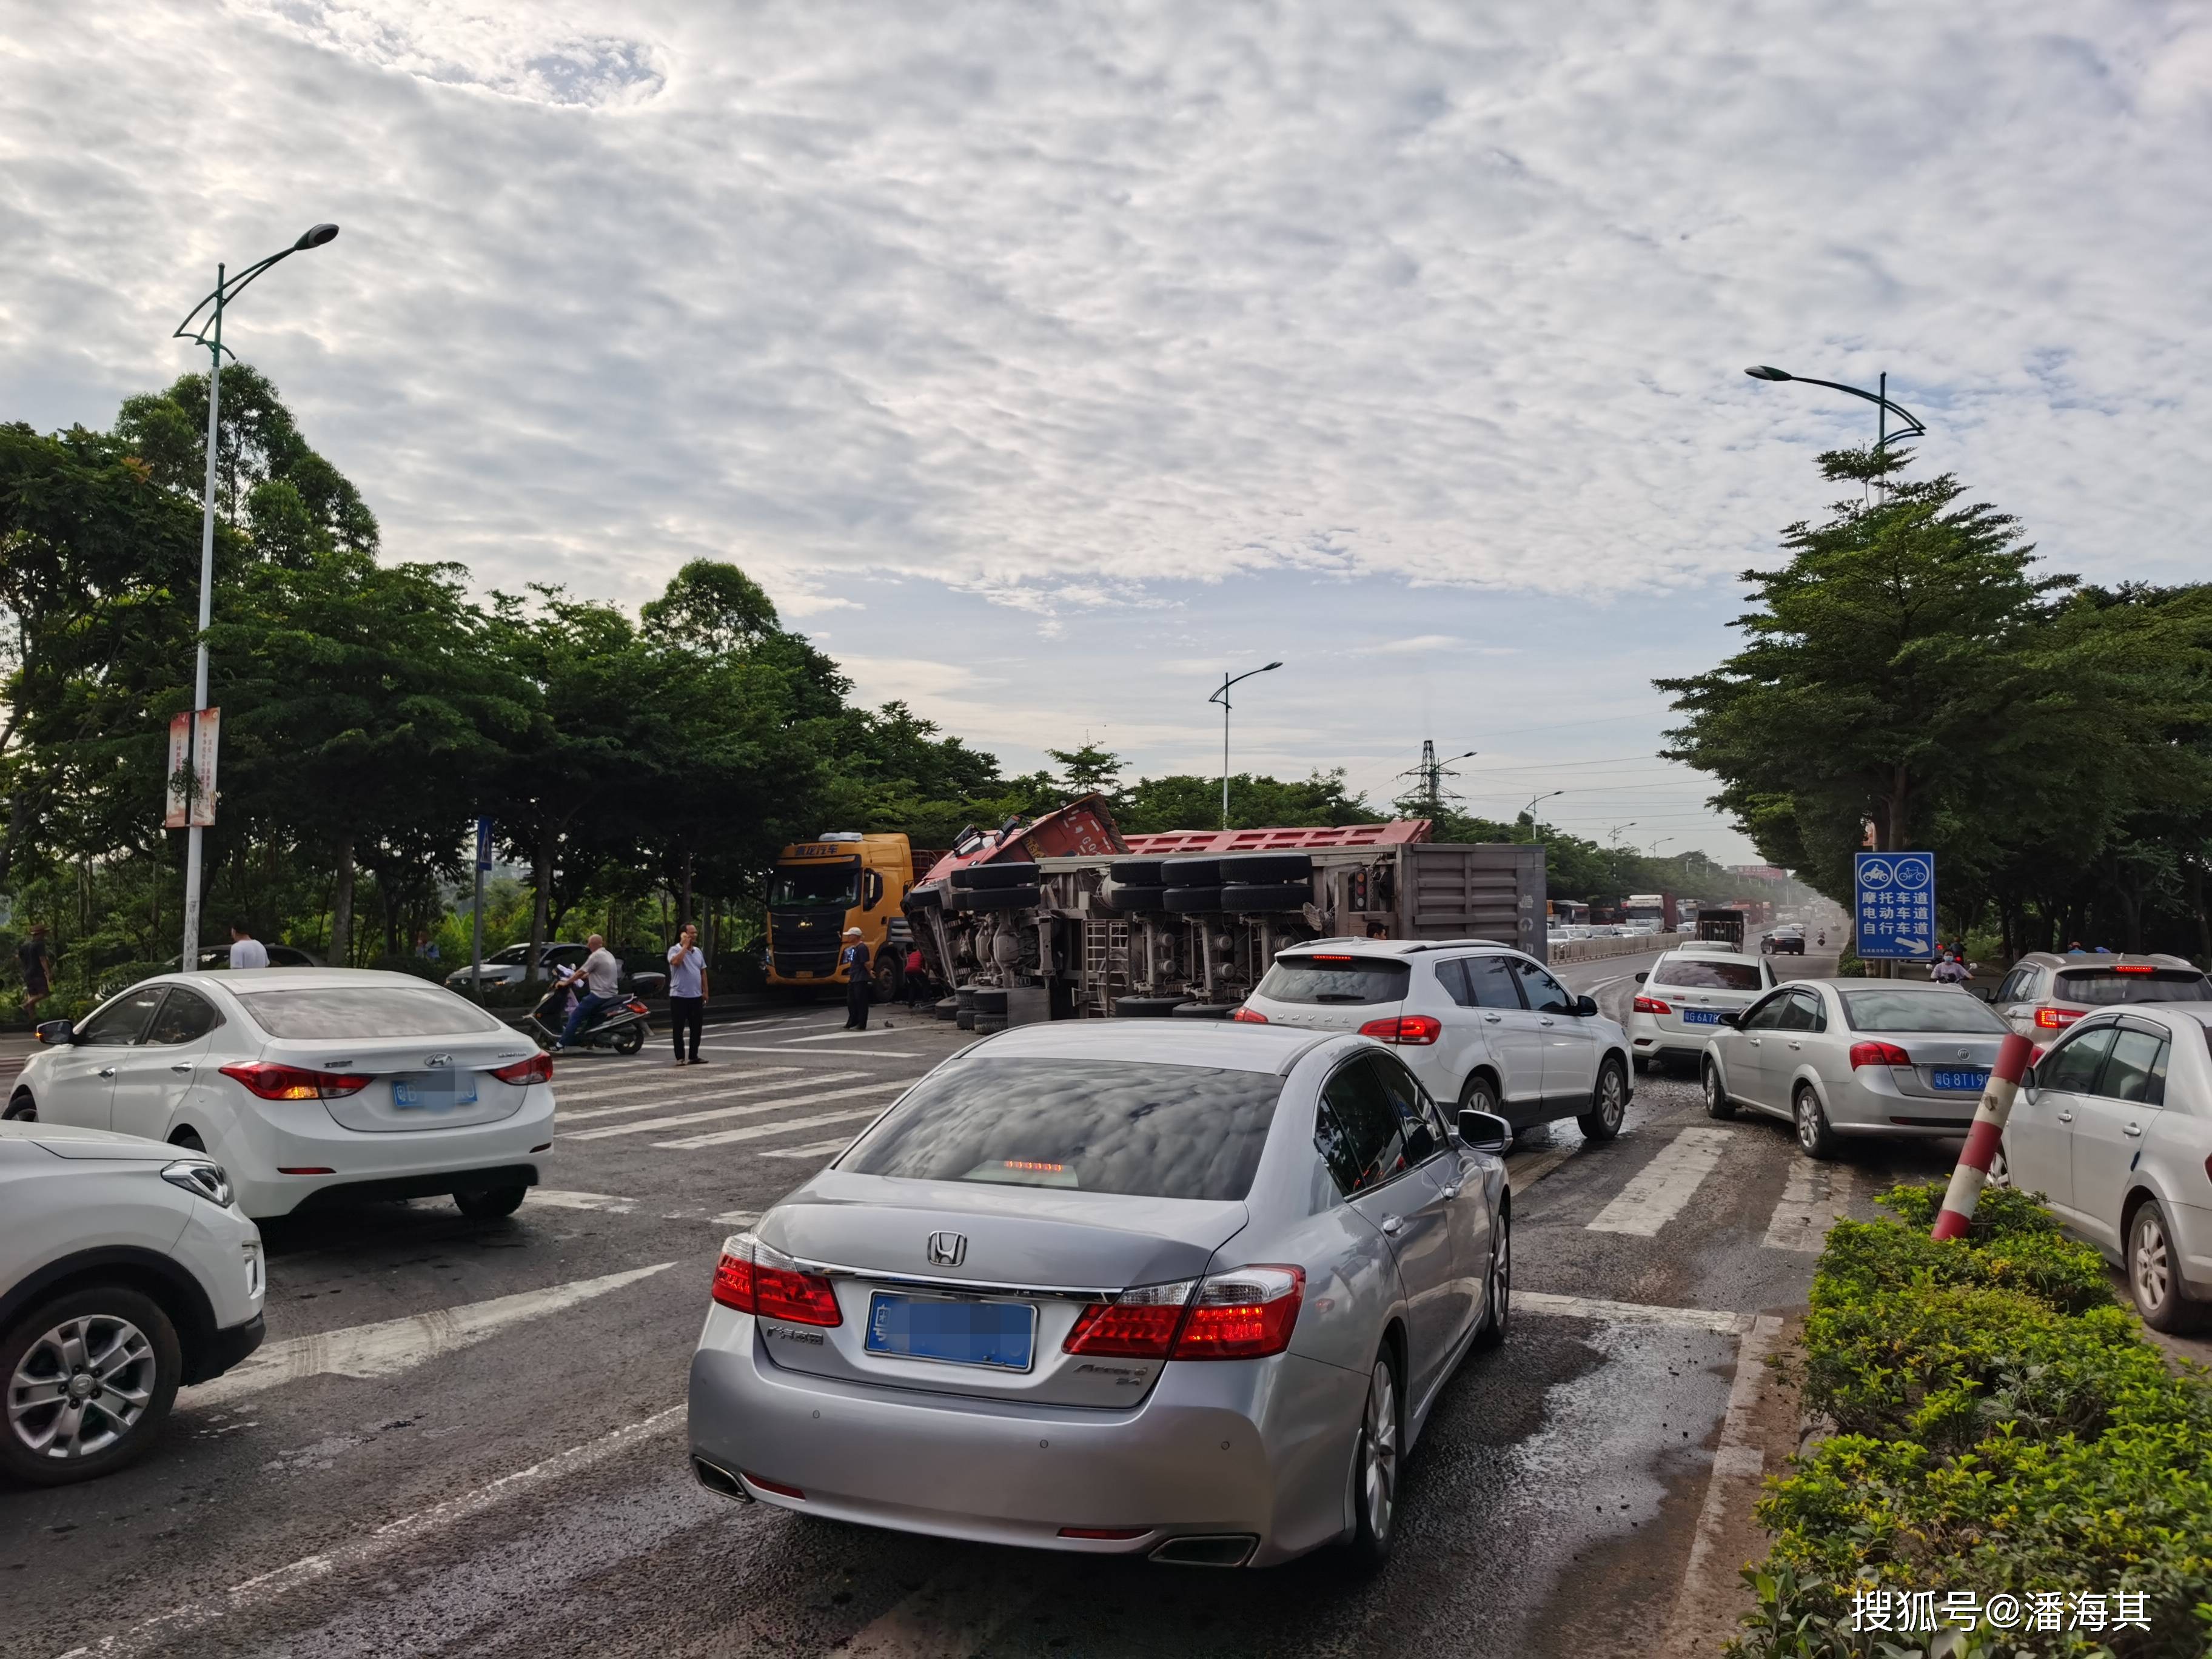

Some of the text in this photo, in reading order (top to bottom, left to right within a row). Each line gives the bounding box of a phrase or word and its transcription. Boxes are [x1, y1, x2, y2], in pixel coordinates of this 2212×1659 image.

[1862, 891, 1928, 904] 摩托车道
[1863, 907, 1928, 920] 电动车道
[1863, 922, 1929, 935] 自行车道
[1277, 1013, 1350, 1024] HAVAL
